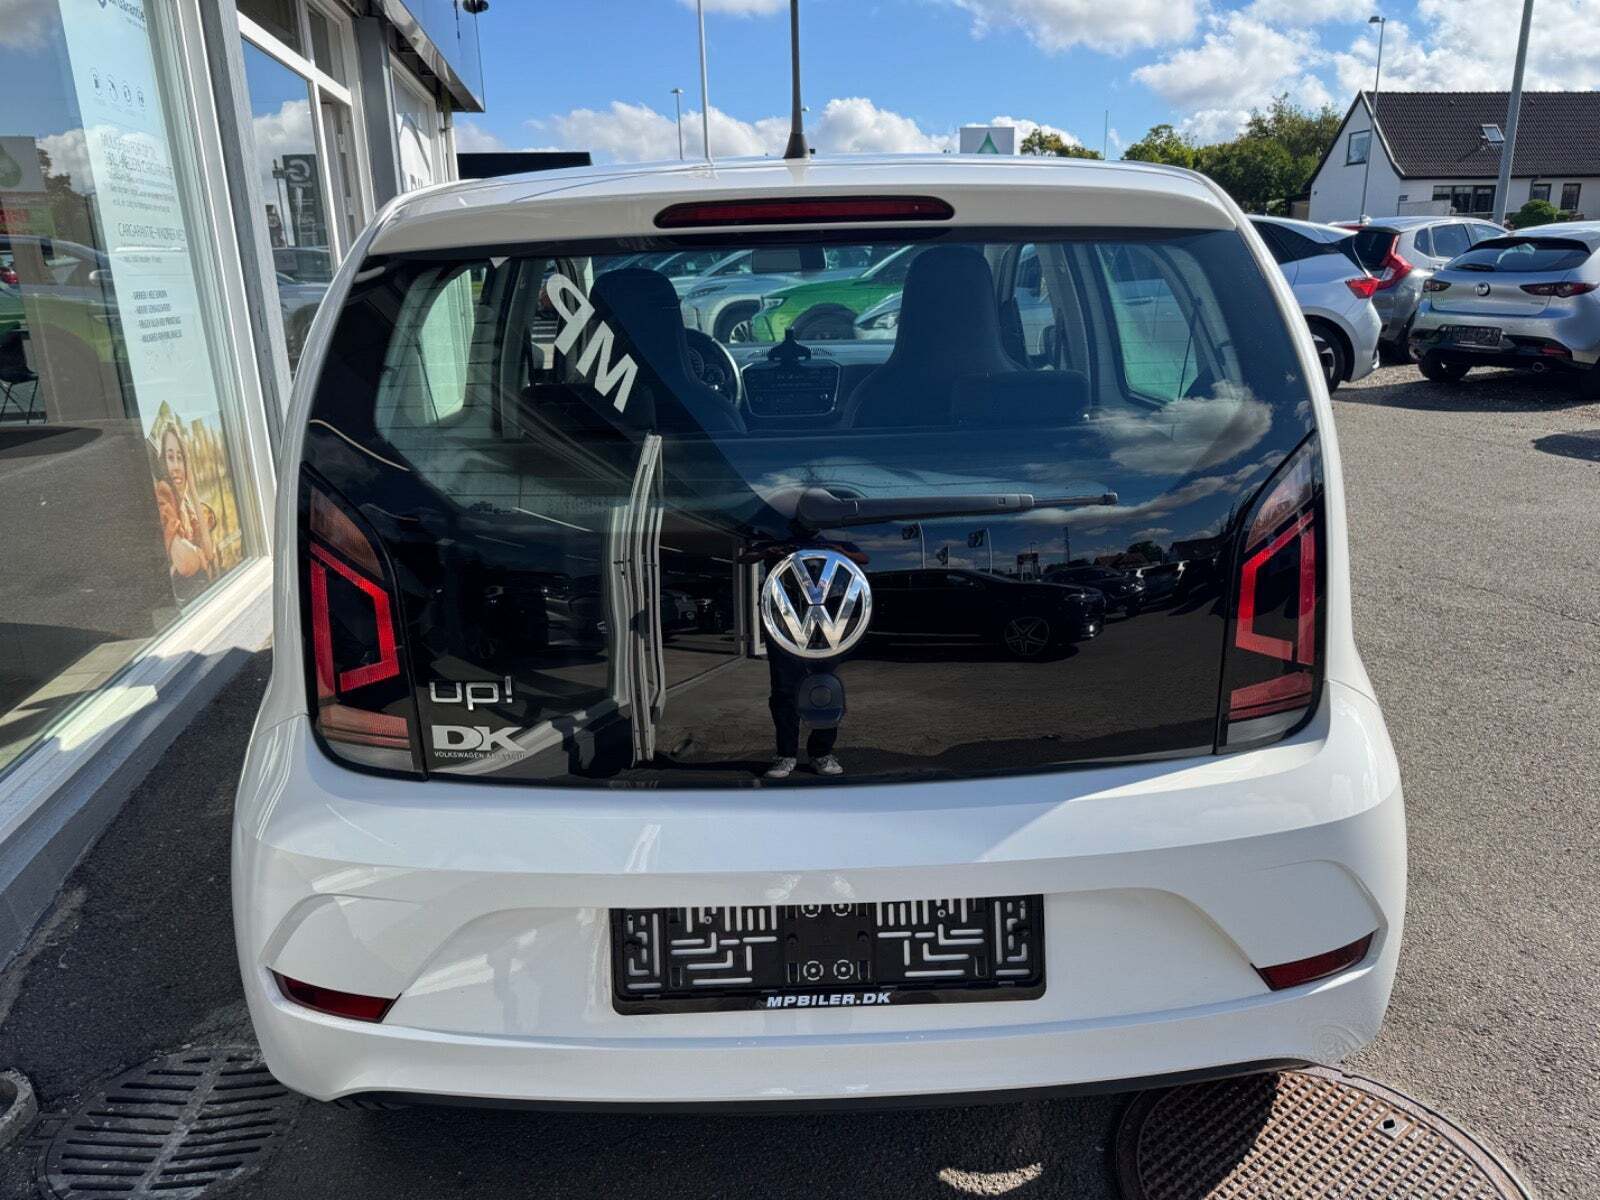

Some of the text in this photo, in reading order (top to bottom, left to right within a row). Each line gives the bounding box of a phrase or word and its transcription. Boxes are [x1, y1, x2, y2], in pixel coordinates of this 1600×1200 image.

[429, 676, 513, 711] up!
[431, 725, 526, 751] DK
[434, 750, 485, 760] VOLKSWAGEN
[766, 992, 891, 1008] MPBILER.DK
